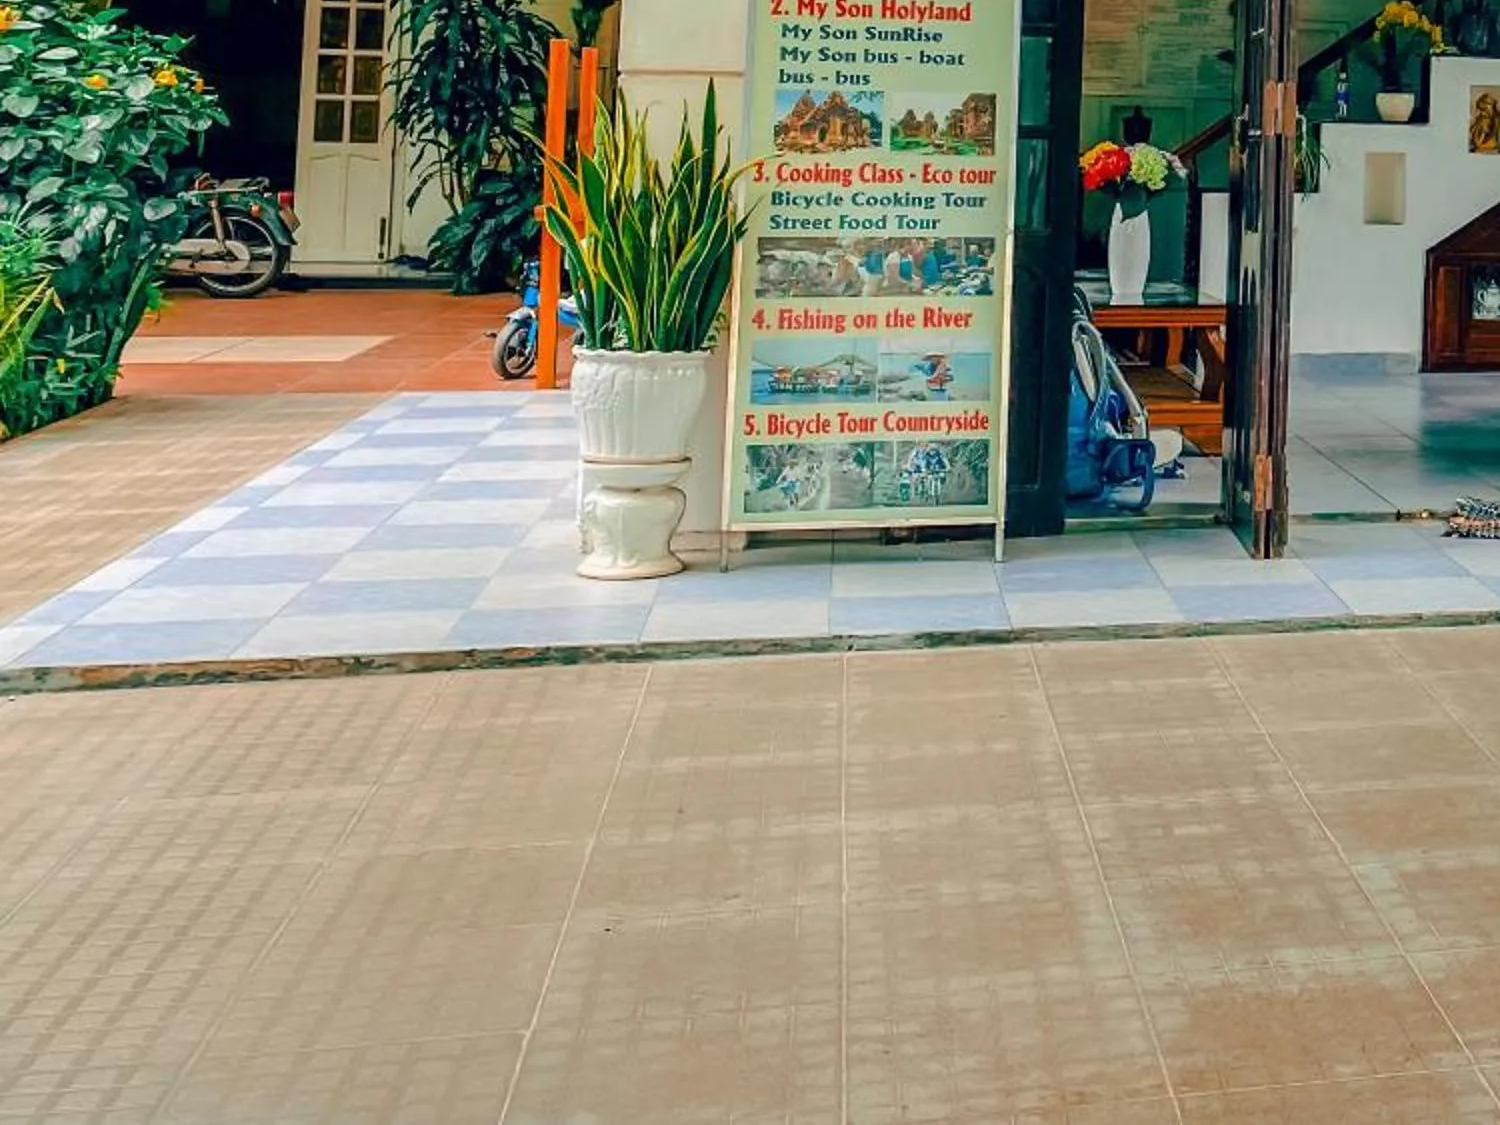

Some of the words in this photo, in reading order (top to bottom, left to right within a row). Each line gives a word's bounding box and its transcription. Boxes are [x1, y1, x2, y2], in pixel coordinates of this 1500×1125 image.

[881, 0, 972, 23] Holyland
[781, 24, 811, 42] My
[819, 25, 857, 41] Son
[865, 26, 943, 43] SunRise
[780, 46, 810, 64] My
[818, 47, 857, 63] Son
[864, 49, 898, 65] bus
[920, 50, 964, 66] boat
[779, 69, 814, 84] bus
[836, 70, 870, 86] bus
[752, 161, 770, 183] 3.
[776, 162, 852, 187] Cooking
[858, 162, 903, 183] Class
[922, 163, 955, 184] Eco
[960, 165, 997, 184] tour
[771, 192, 843, 210] Bicycle
[851, 193, 935, 210] Cooking
[944, 193, 987, 208] Tour
[770, 214, 832, 230] Street
[839, 214, 887, 230] Food
[895, 215, 941, 230] Tour
[752, 309, 770, 330] 4.
[778, 308, 846, 333] Fishing
[854, 311, 877, 328] on
[886, 307, 915, 327] the
[922, 307, 972, 328] River
[744, 414, 760, 436] 5.
[767, 413, 831, 439] Bicycle
[838, 412, 877, 432] Tour
[883, 410, 989, 434] Countryside
